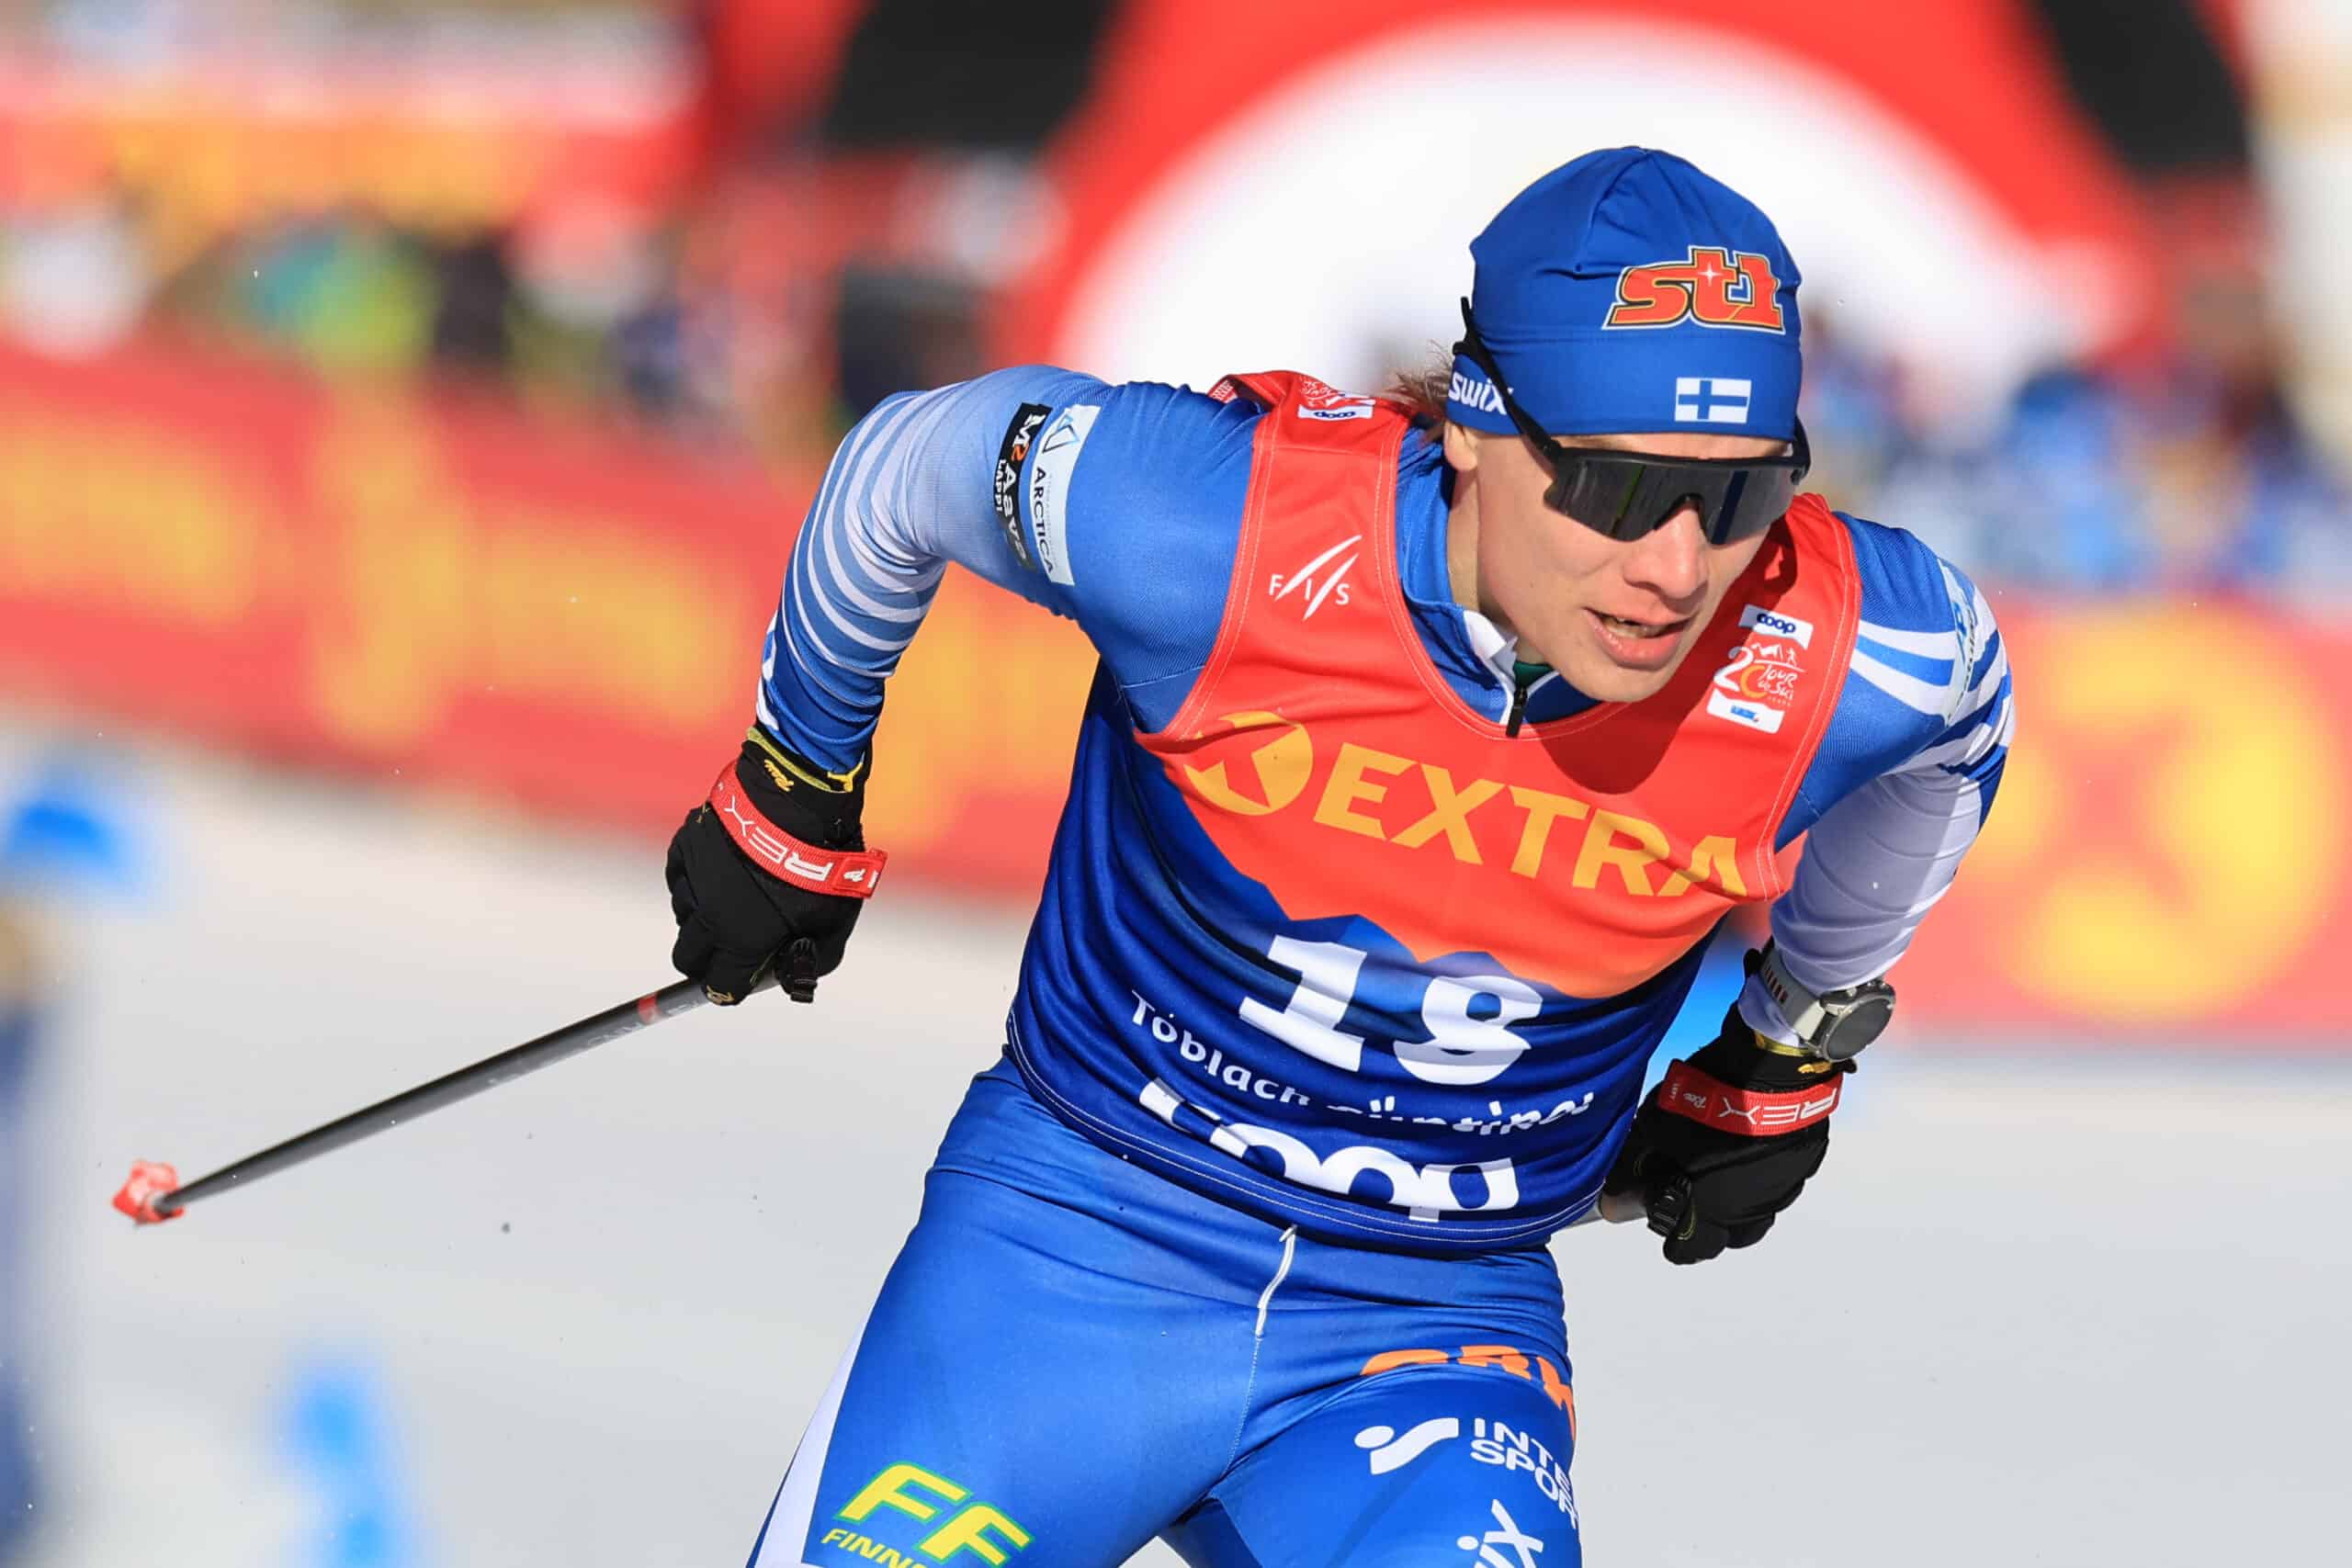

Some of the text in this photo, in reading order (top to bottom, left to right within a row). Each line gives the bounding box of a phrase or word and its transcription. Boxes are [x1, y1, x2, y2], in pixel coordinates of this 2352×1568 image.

[1033, 466, 1054, 573] ARCTICA
[1756, 612, 1796, 635] coop
[1313, 741, 1747, 897] EXTRA
[1238, 934, 1544, 1086] 18
[833, 1461, 1035, 1567] FF
